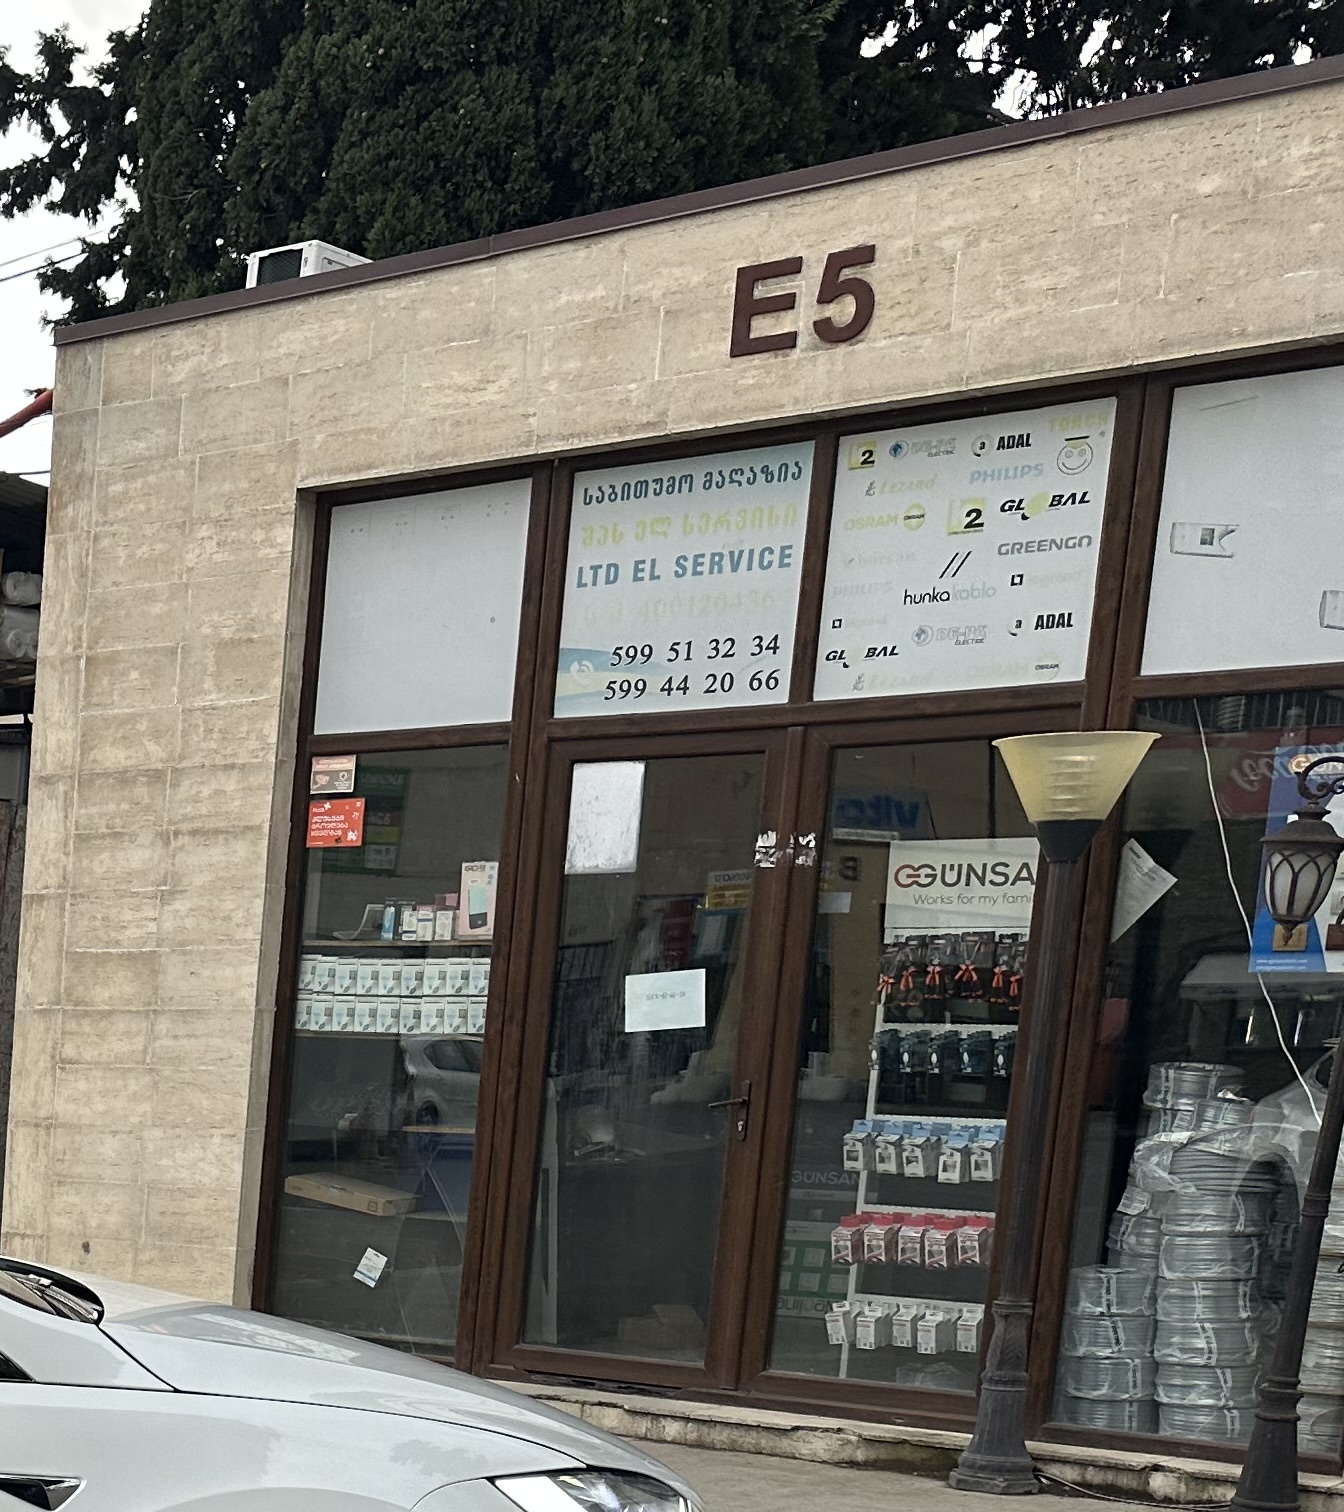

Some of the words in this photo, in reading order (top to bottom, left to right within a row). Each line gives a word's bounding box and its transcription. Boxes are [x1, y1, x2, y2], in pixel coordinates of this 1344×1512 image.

[730, 244, 876, 358] E5
[996, 433, 1032, 451] ADAL
[582, 473, 694, 506] საბითუმო
[703, 460, 803, 491] მაღაზია
[969, 463, 1045, 484] PHILIPS
[581, 522, 624, 548] შპს
[682, 502, 799, 536] სერვისი
[998, 534, 1092, 556] GREENGO
[576, 562, 620, 588] LTD
[632, 558, 661, 583] EL
[674, 544, 793, 578] SERVICE
[1034, 612, 1074, 630] ADAL
[610, 644, 653, 667] 599
[666, 640, 693, 663] 51
[706, 637, 736, 660] 32
[750, 633, 780, 657] 34
[604, 678, 647, 701] 599
[659, 675, 690, 696] 44
[703, 672, 735, 694] 20
[748, 668, 781, 692] 66
[912, 862, 1036, 888] GÜNSA
[913, 893, 954, 905] Works
[957, 892, 976, 905] for
[978, 895, 999, 907] my
